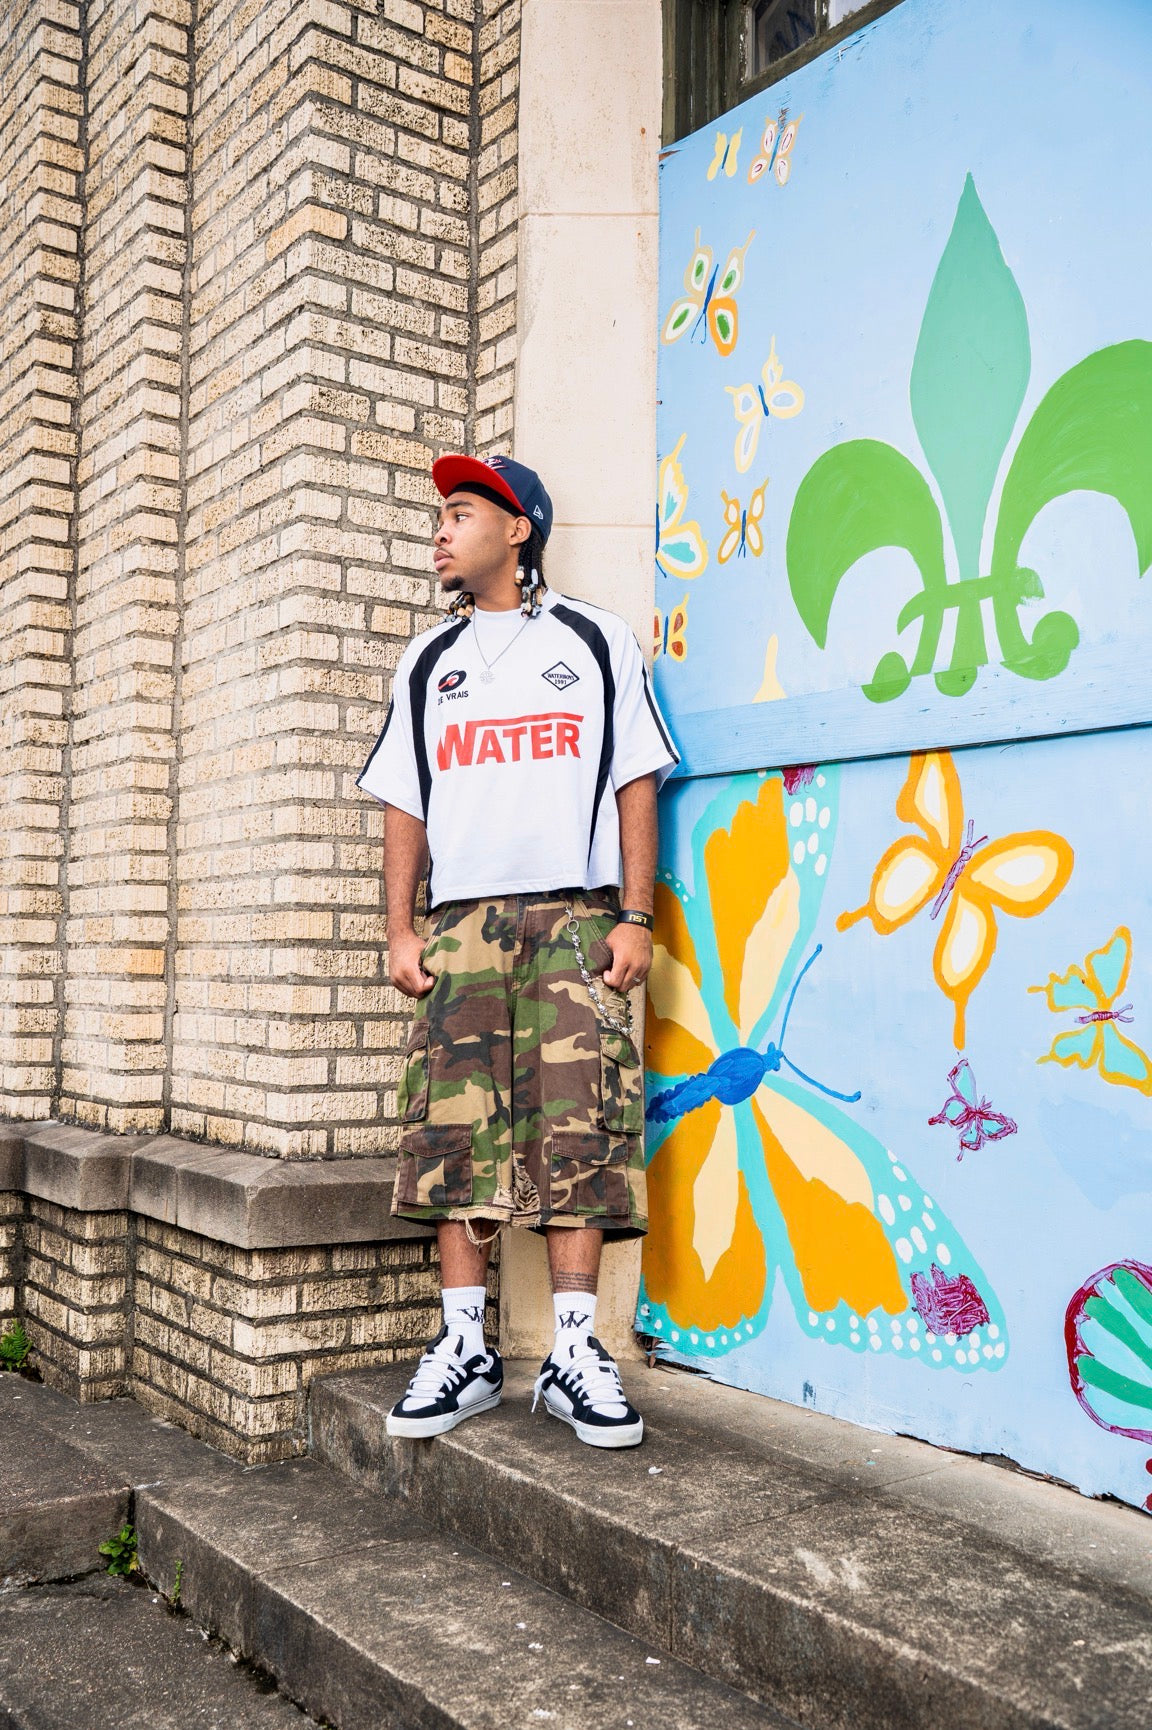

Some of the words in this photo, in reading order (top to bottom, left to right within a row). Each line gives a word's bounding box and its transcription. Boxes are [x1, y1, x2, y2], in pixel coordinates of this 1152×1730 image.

[446, 690, 469, 701] VRAIS
[437, 712, 584, 771] WATER
[629, 914, 647, 924] LSU
